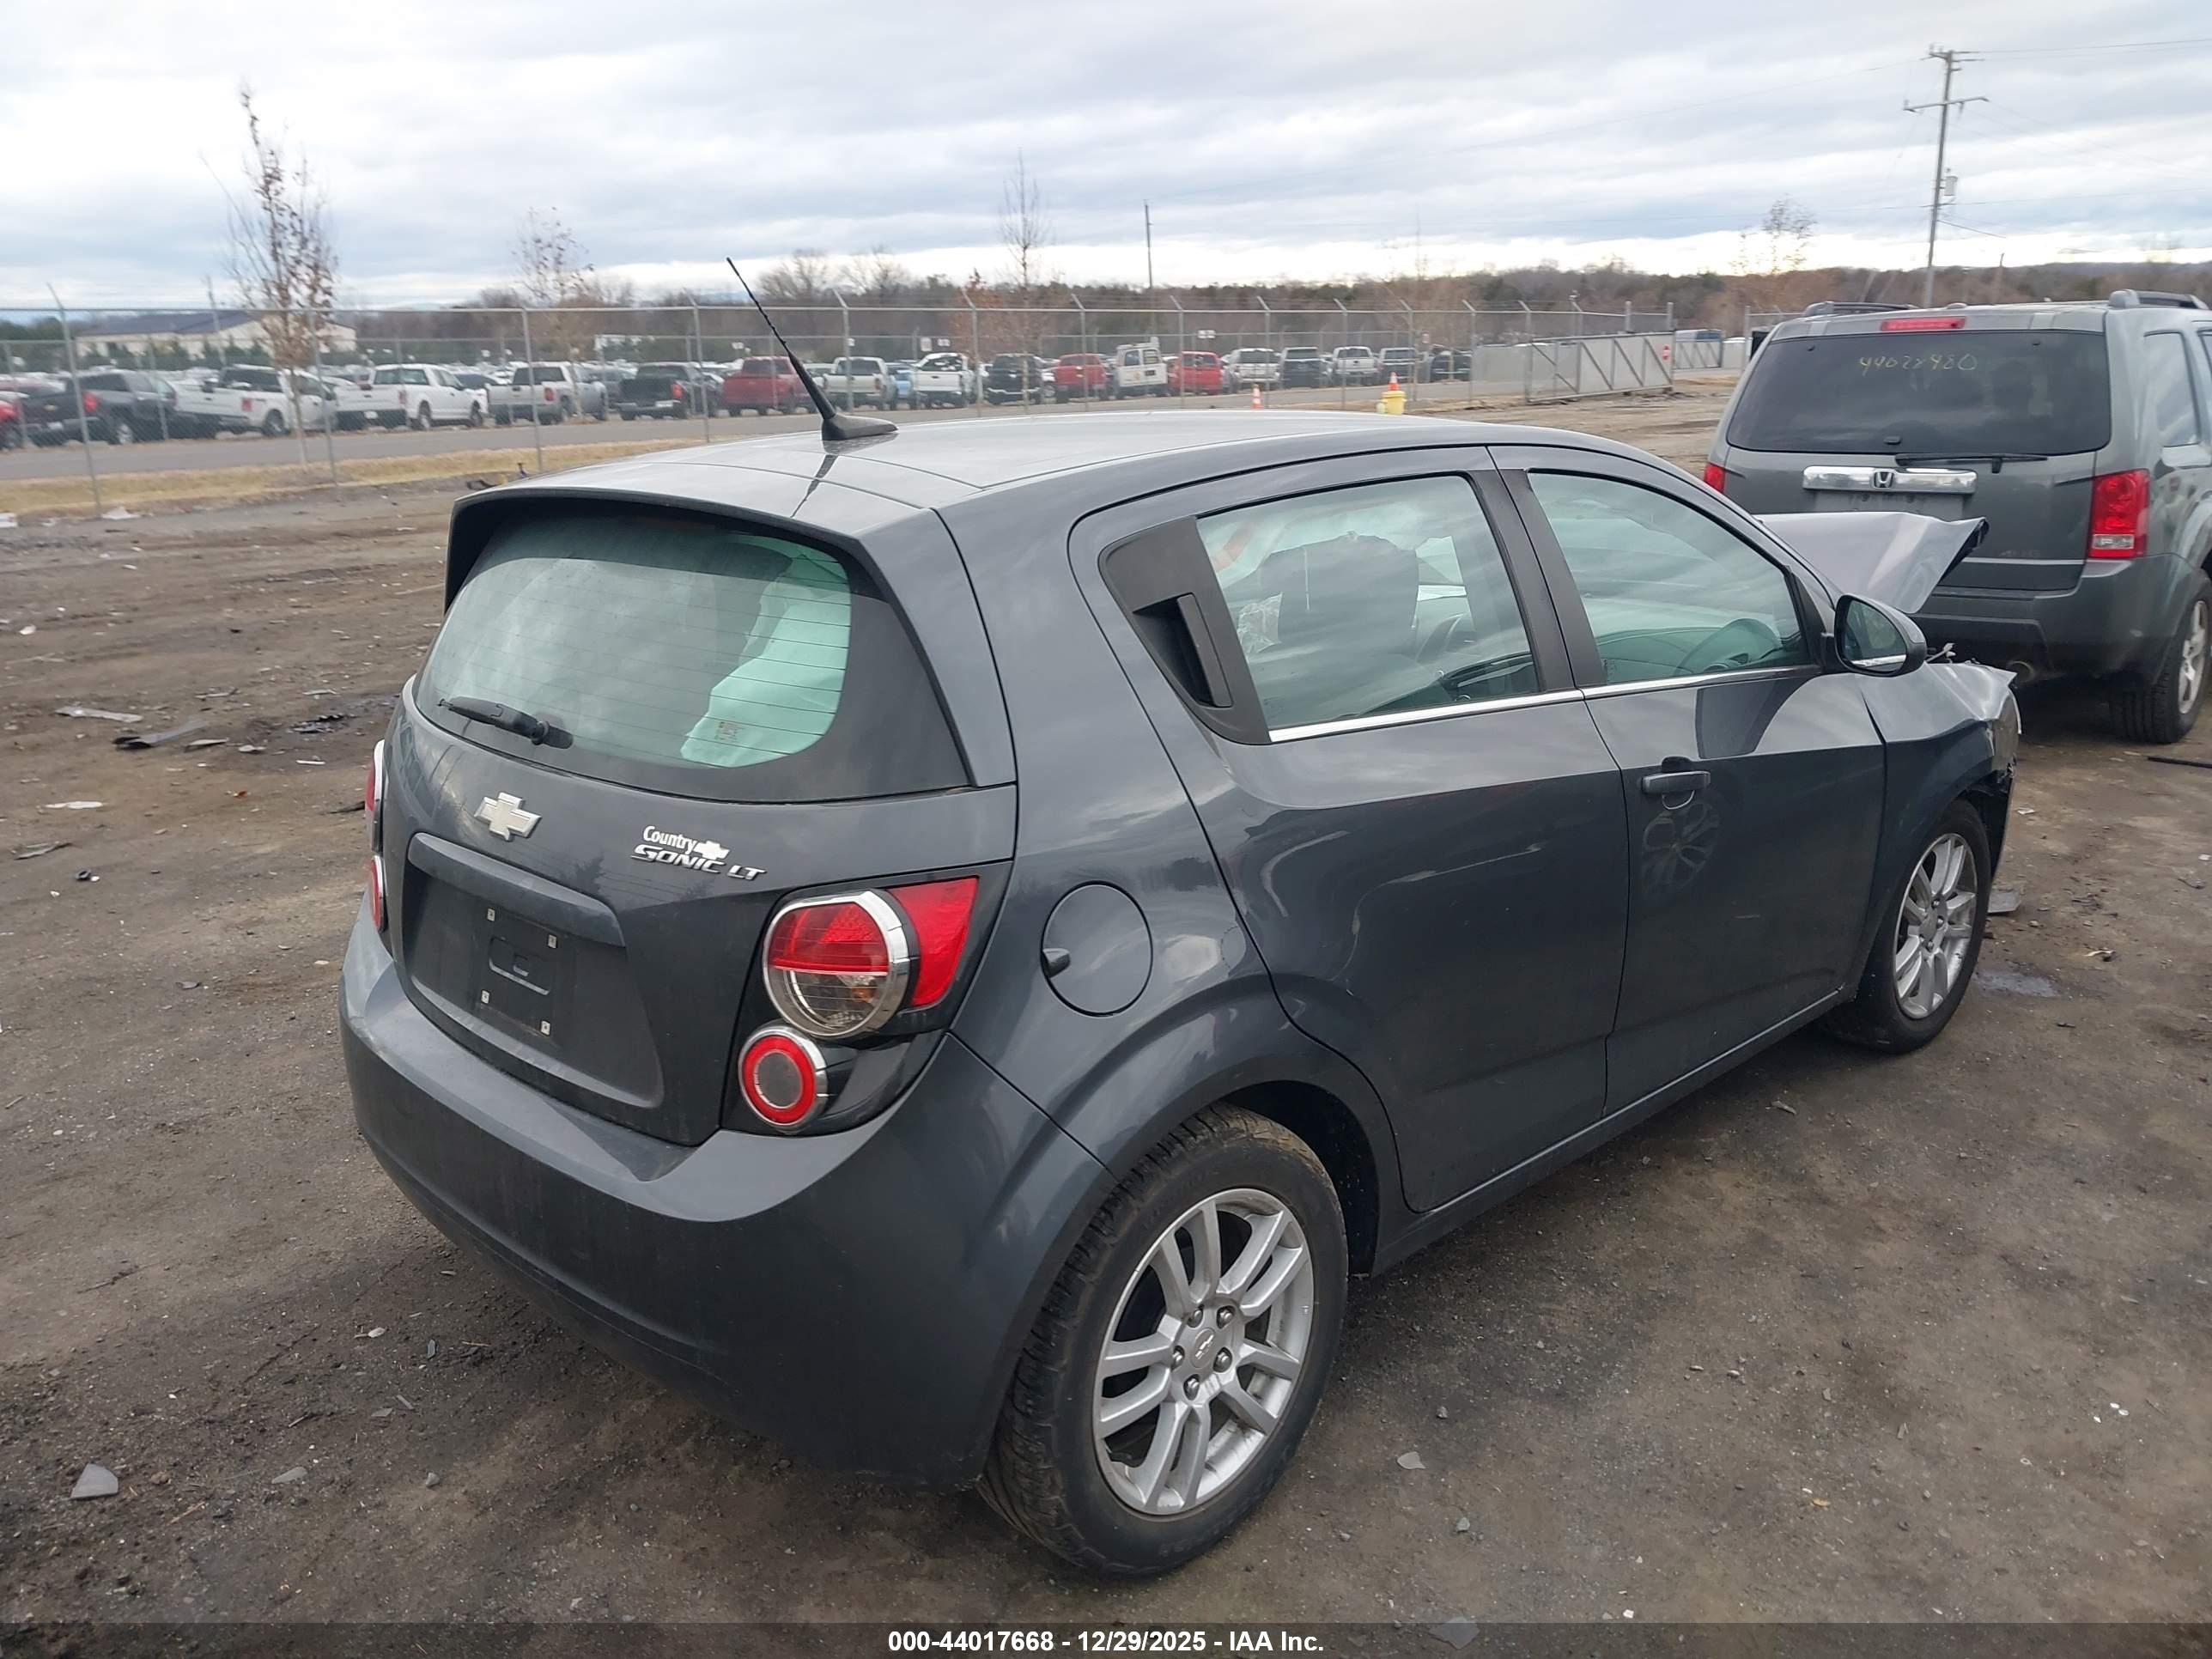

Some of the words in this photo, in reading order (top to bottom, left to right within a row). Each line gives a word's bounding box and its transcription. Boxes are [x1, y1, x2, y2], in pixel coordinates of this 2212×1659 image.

[643, 825, 697, 856] Country
[631, 843, 726, 874] SONIC
[727, 864, 767, 881] LT
